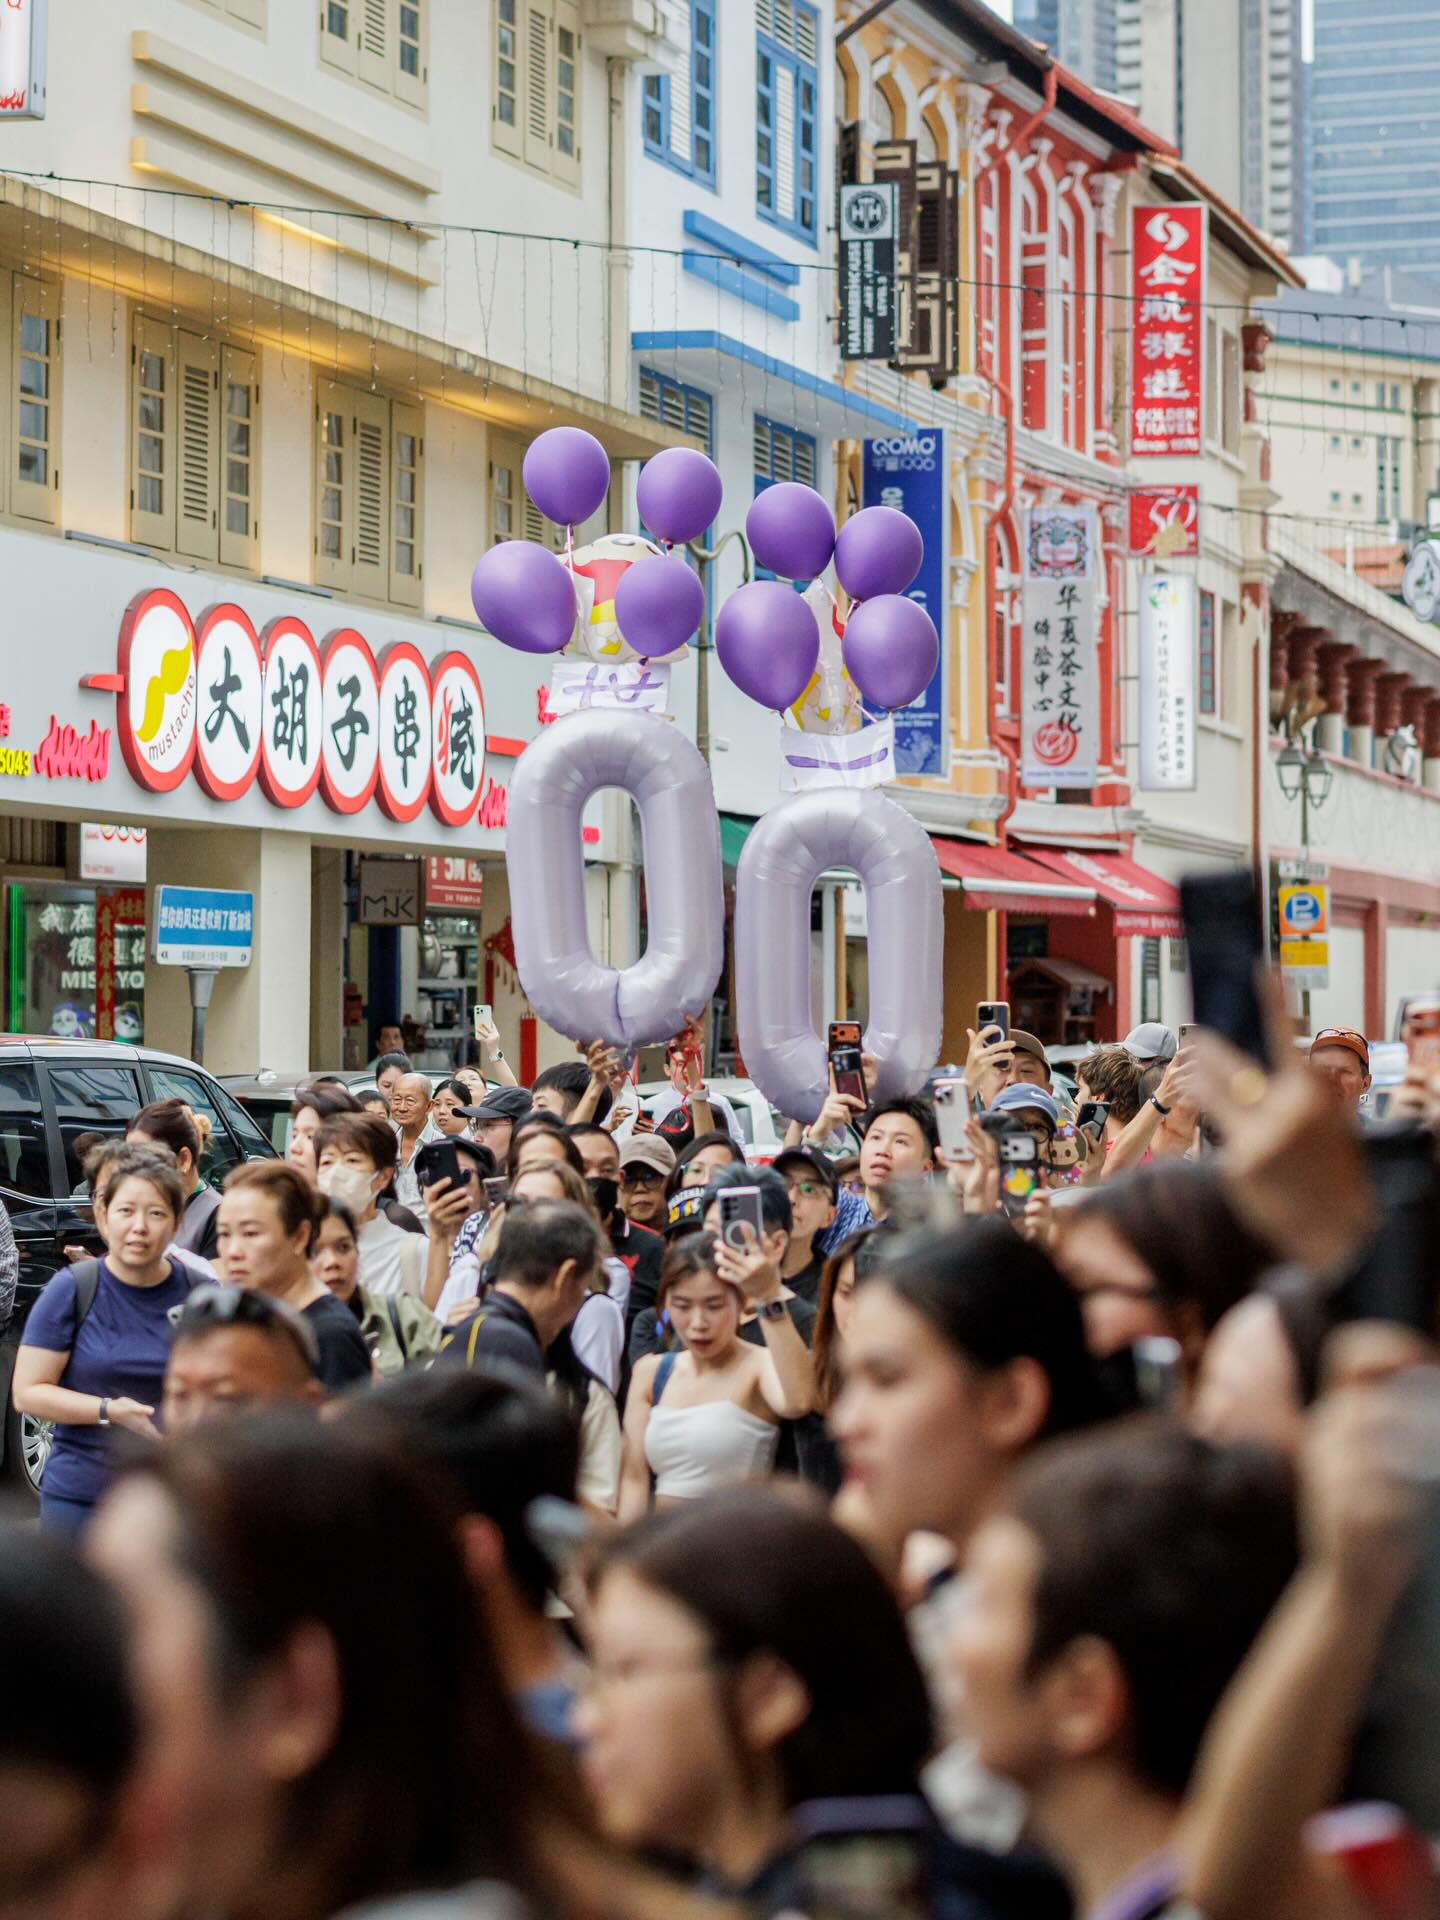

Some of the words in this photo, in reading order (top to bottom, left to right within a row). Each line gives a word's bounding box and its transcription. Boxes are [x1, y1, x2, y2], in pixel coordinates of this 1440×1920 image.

[1135, 407, 1198, 421] GOLDEN
[1136, 420, 1197, 435] TRAVEL
[1056, 584, 1083, 734] 华夏茶文化
[148, 674, 196, 761] mustache
[61, 971, 97, 989] MIS
[116, 971, 145, 989] YO
